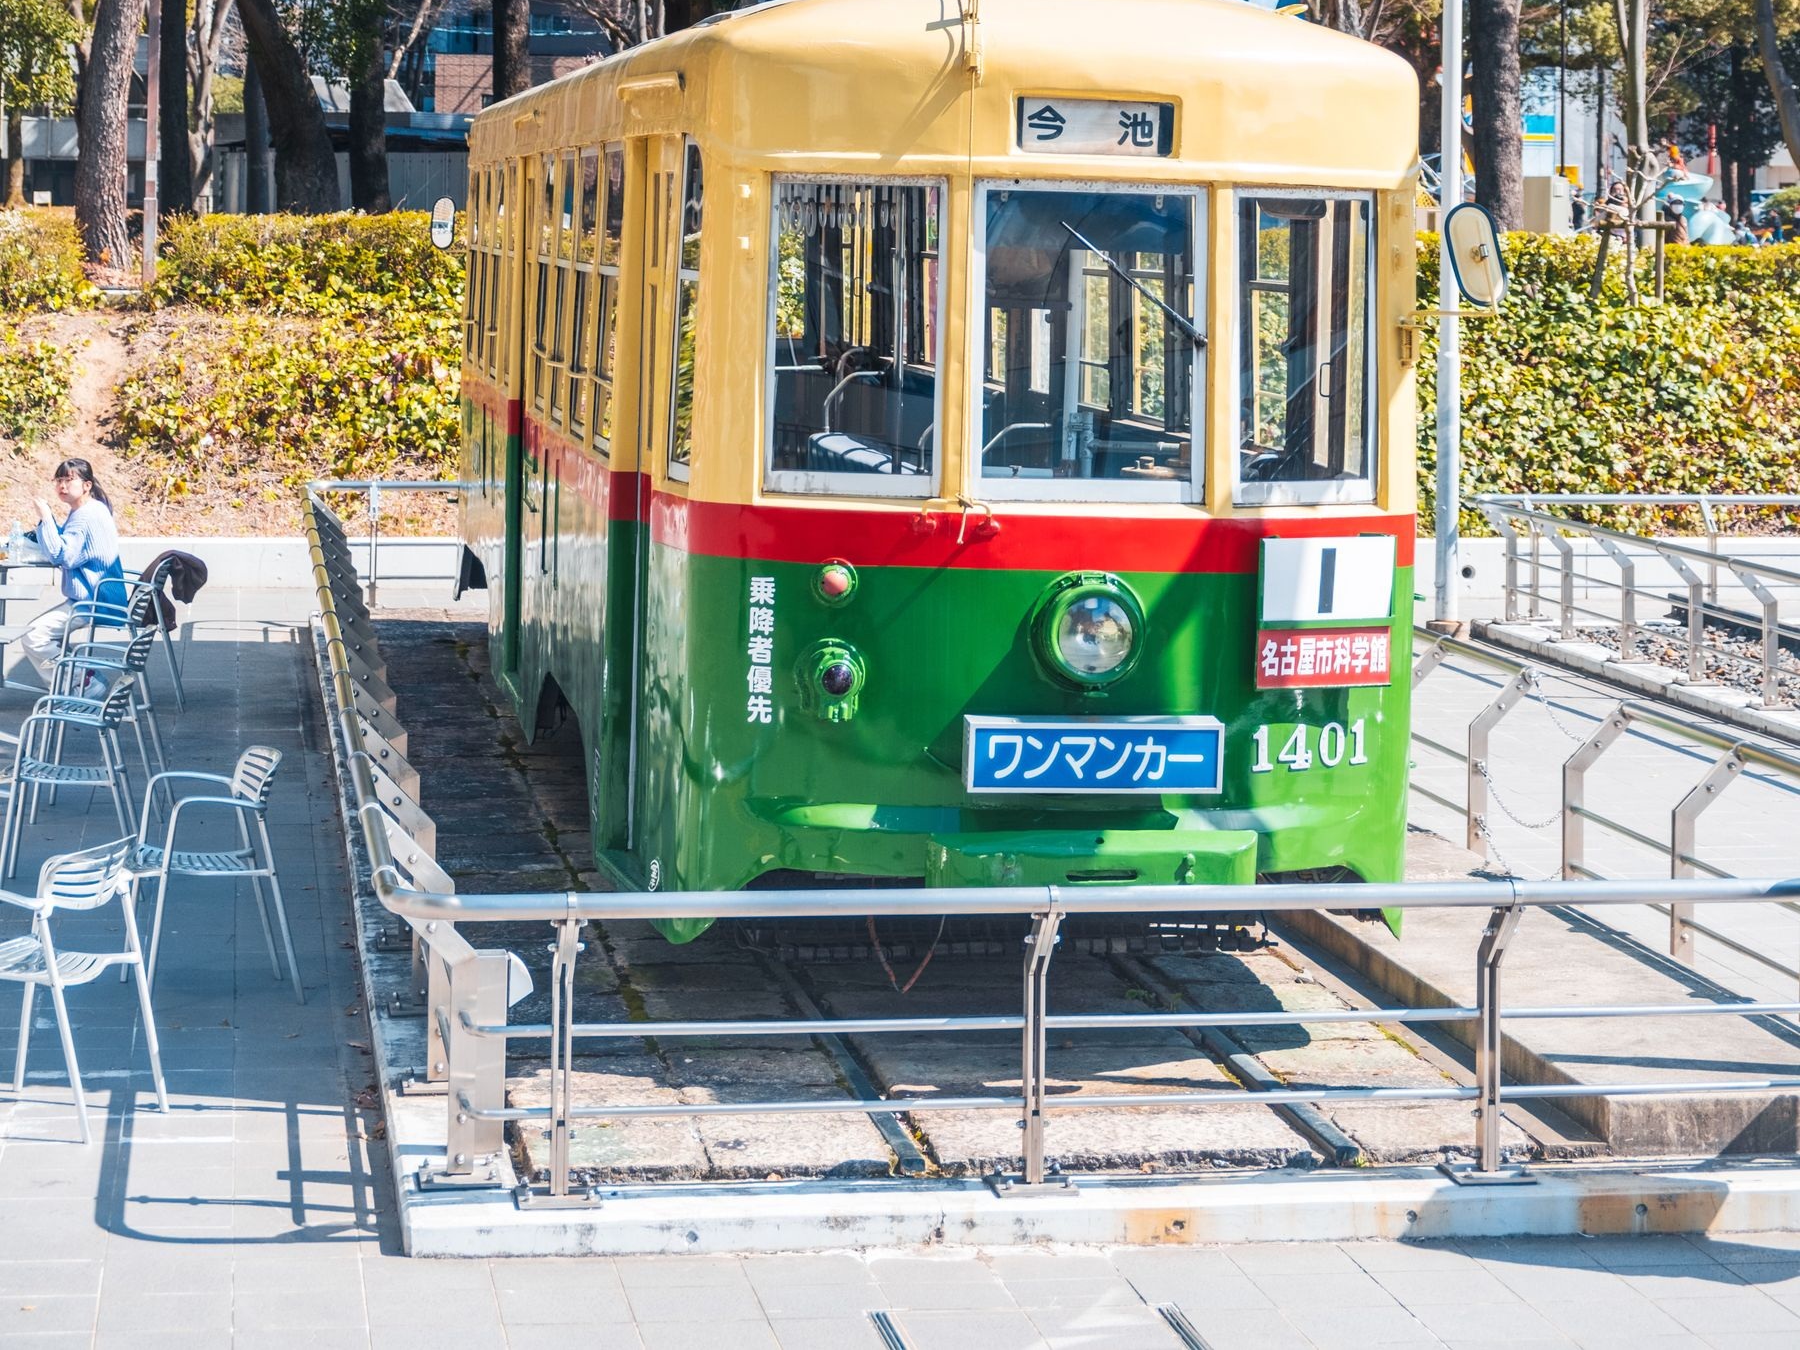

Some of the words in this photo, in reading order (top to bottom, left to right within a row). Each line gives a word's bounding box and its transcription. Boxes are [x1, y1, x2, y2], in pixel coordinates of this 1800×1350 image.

[1027, 104, 1154, 148] 今池
[747, 576, 776, 724] 乗降者優先
[1261, 635, 1388, 677] 名古屋市科学館
[988, 735, 1205, 782] ワンマンカー
[1251, 718, 1369, 773] 1401
